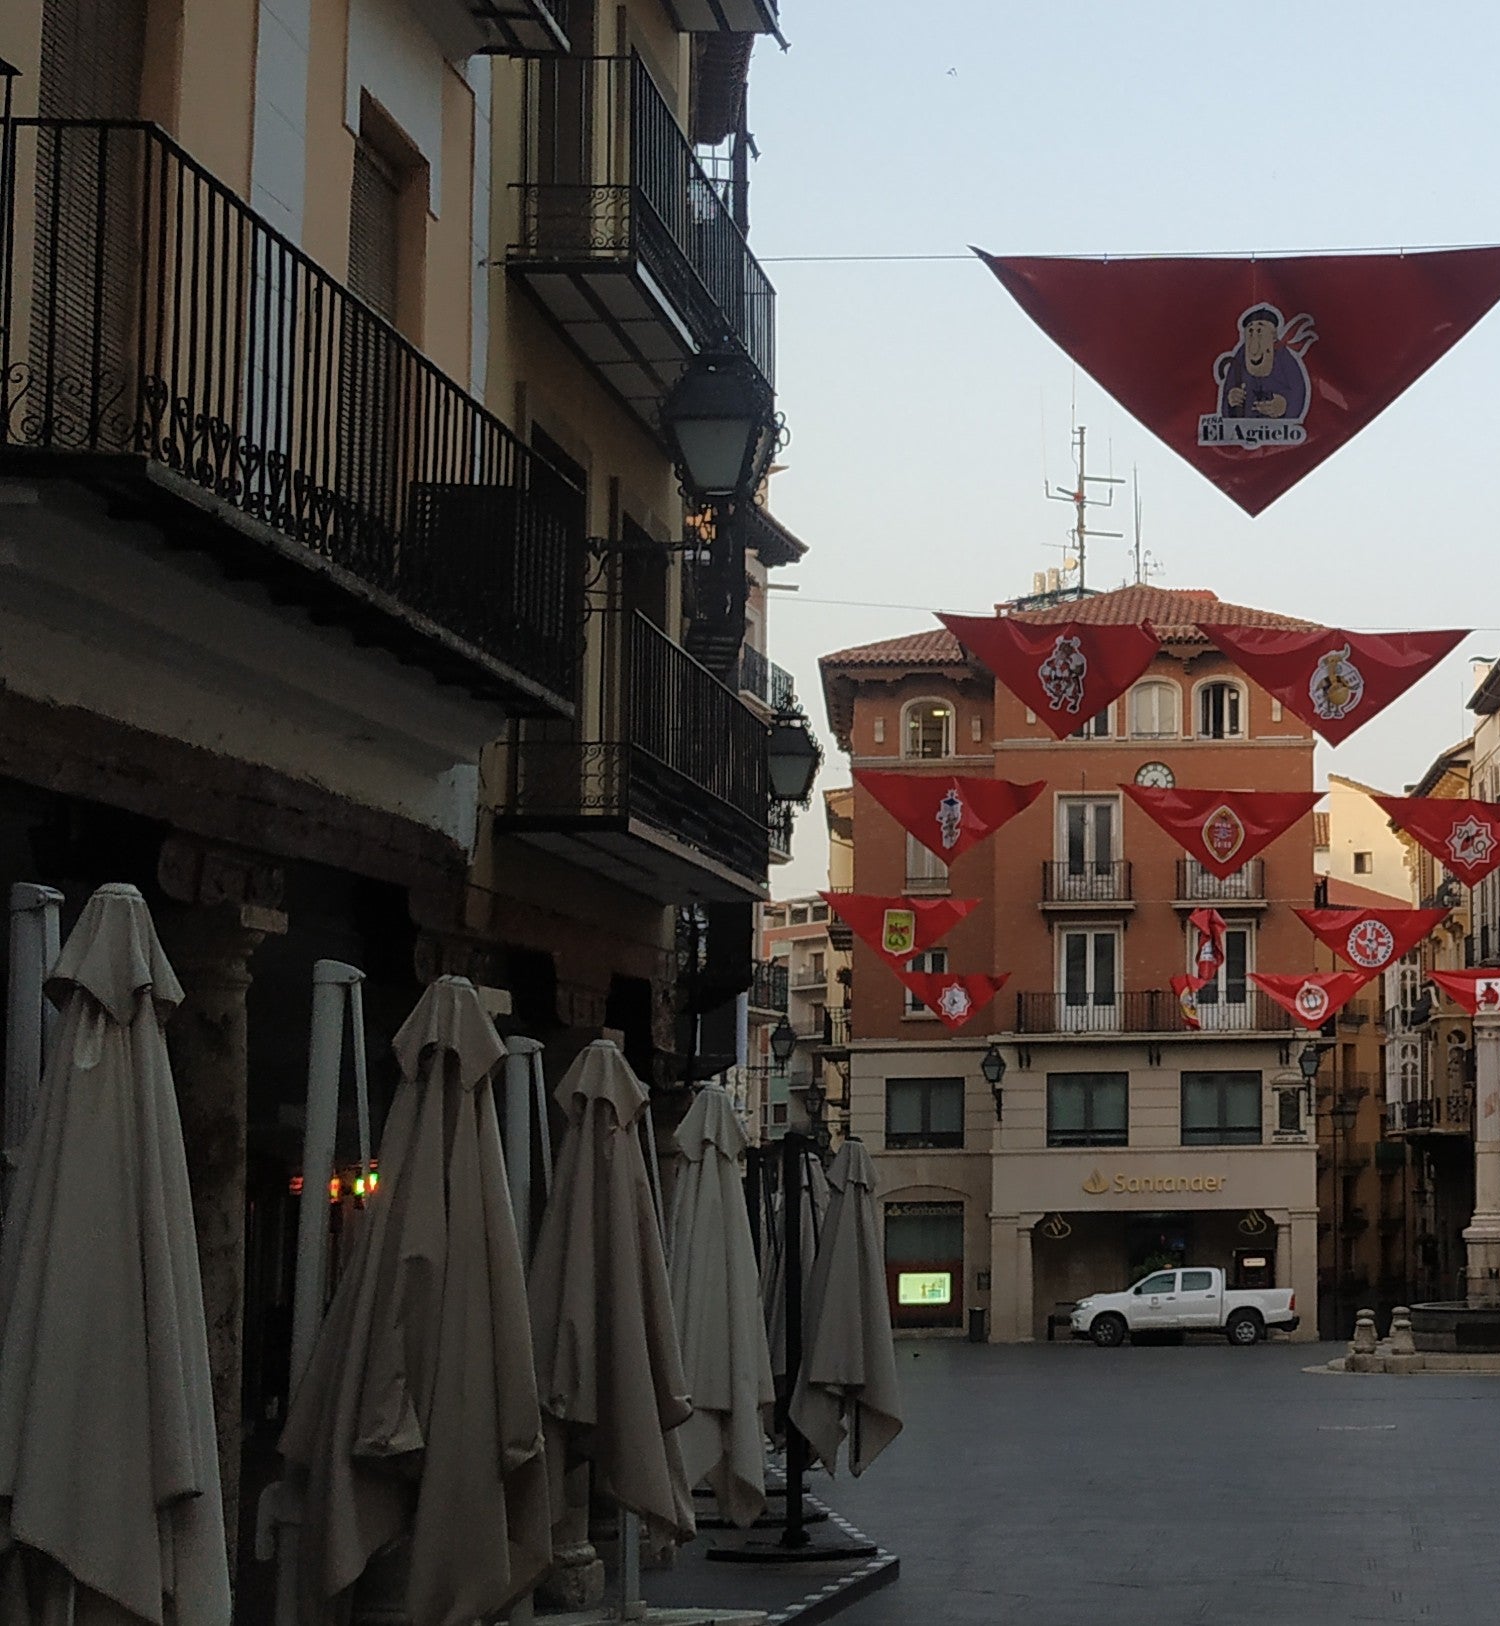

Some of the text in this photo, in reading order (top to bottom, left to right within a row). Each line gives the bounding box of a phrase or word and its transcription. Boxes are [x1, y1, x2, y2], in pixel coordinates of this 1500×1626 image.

[1202, 425, 1301, 443] El Agüelo
[1113, 1174, 1226, 1192] Santander
